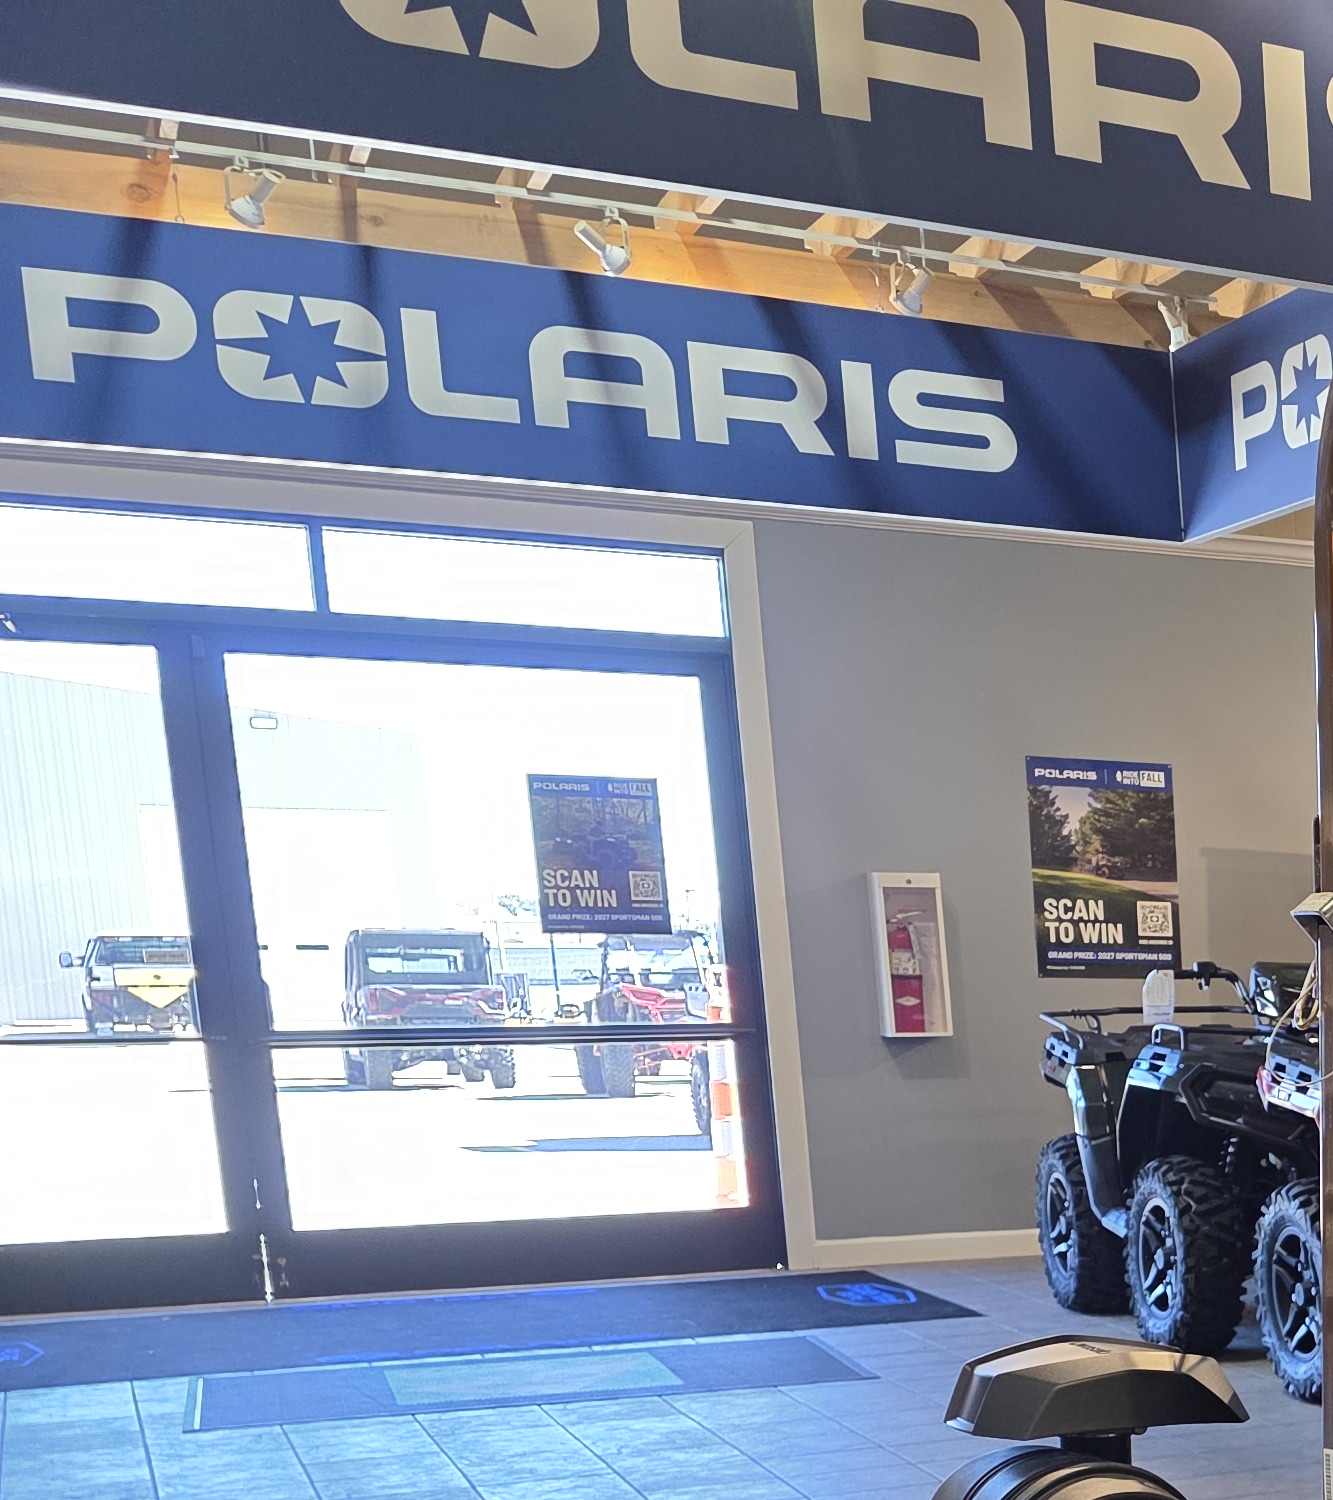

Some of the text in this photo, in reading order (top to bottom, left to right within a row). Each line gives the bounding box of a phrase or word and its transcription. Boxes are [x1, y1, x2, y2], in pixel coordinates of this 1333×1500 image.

[21, 266, 1018, 473] POLARIS
[1034, 768, 1097, 780] POLARIS
[1141, 772, 1163, 783] FALL
[533, 782, 590, 791] POLARIS
[631, 782, 651, 792] FALL
[542, 869, 599, 888] SCAN
[544, 889, 618, 908] TO WIN
[1043, 898, 1105, 920] SCAN
[1044, 921, 1124, 944] TO WIN
